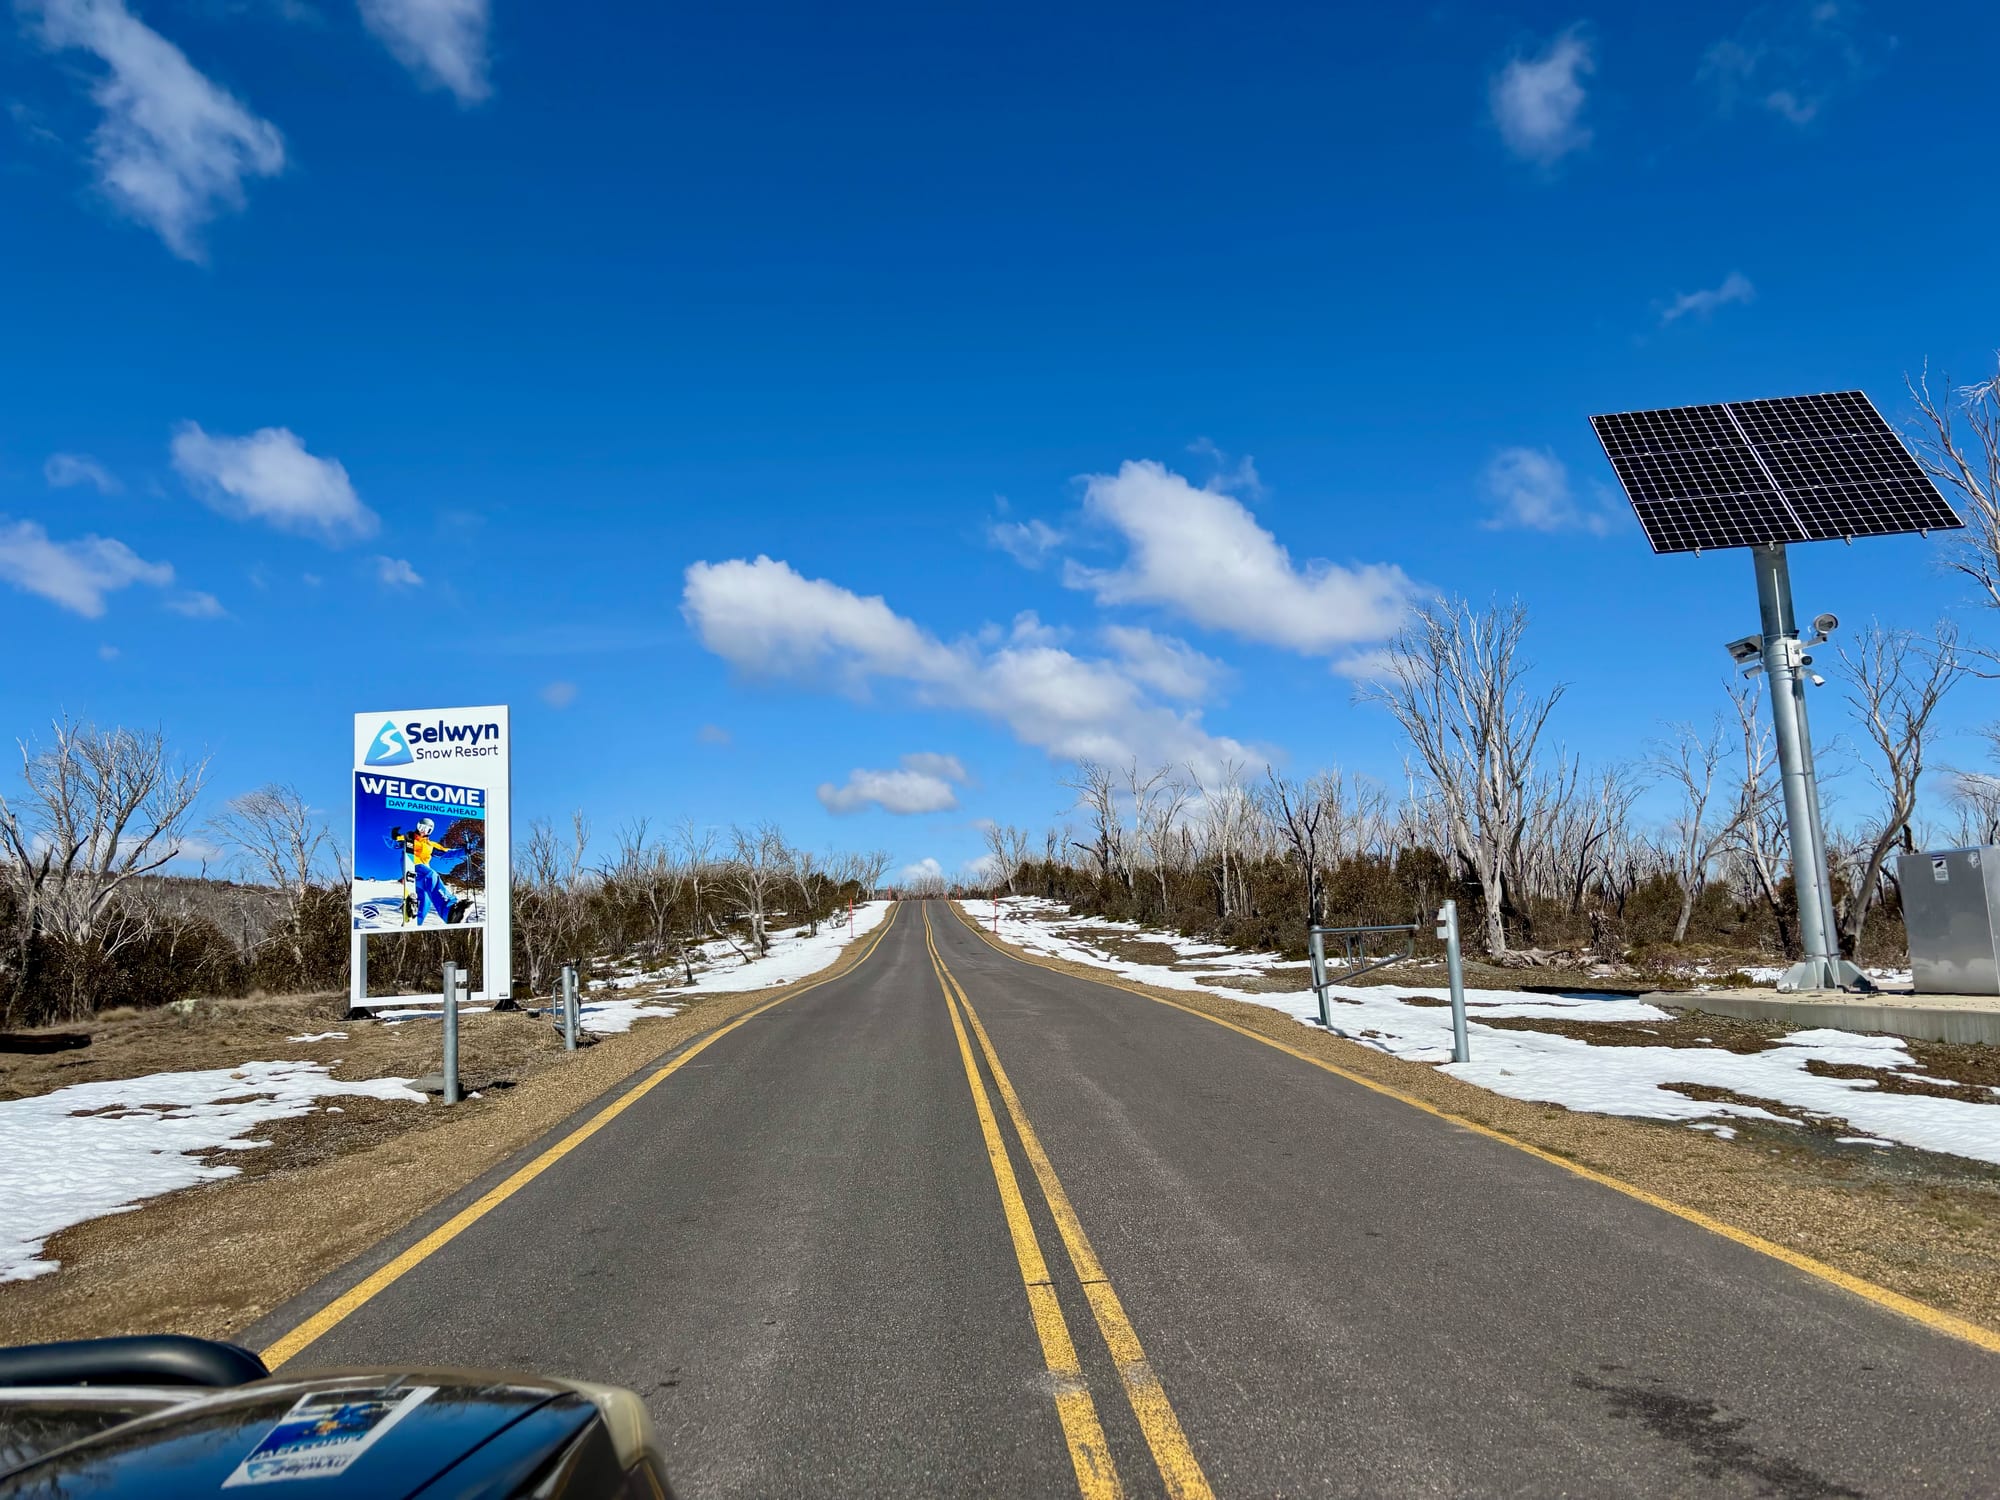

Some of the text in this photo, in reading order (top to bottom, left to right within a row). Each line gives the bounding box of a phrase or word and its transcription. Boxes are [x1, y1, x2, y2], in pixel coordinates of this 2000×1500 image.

[405, 720, 499, 745] Selwyn
[416, 745, 498, 760] Snow Resort
[359, 776, 480, 807] WELCOME
[388, 799, 477, 816] DAY PARKING AHEAD
